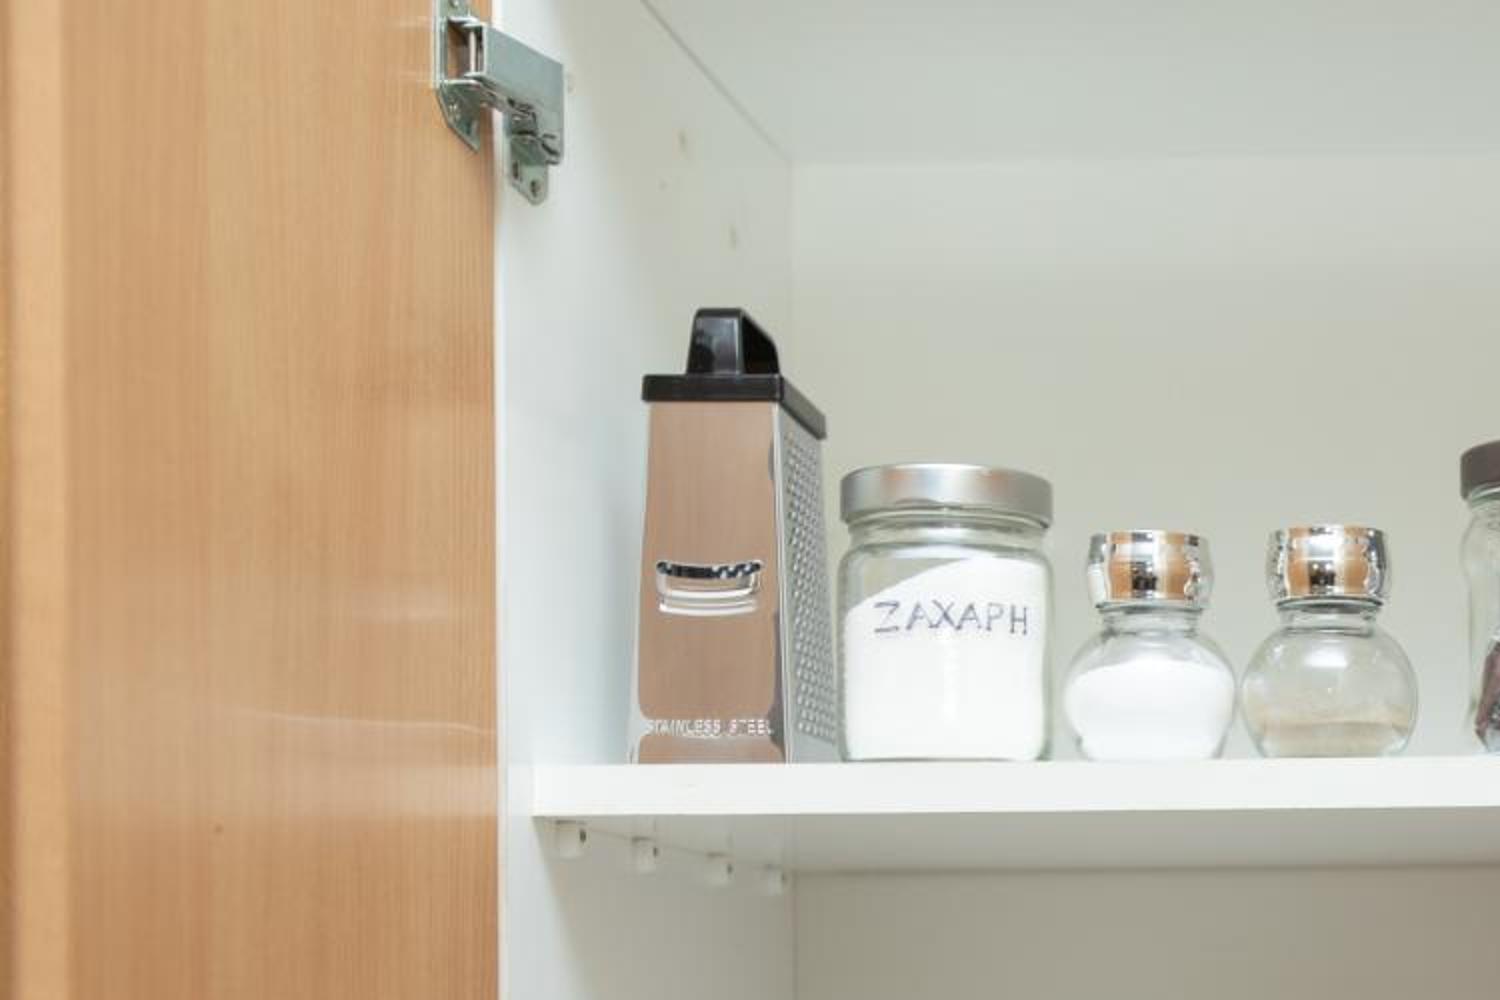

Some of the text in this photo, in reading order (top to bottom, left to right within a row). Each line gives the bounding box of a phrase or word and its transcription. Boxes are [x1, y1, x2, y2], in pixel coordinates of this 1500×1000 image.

[873, 599, 1028, 636] ΖΑΧΑΡΗ
[646, 718, 775, 738] STAINLESS STEEL
